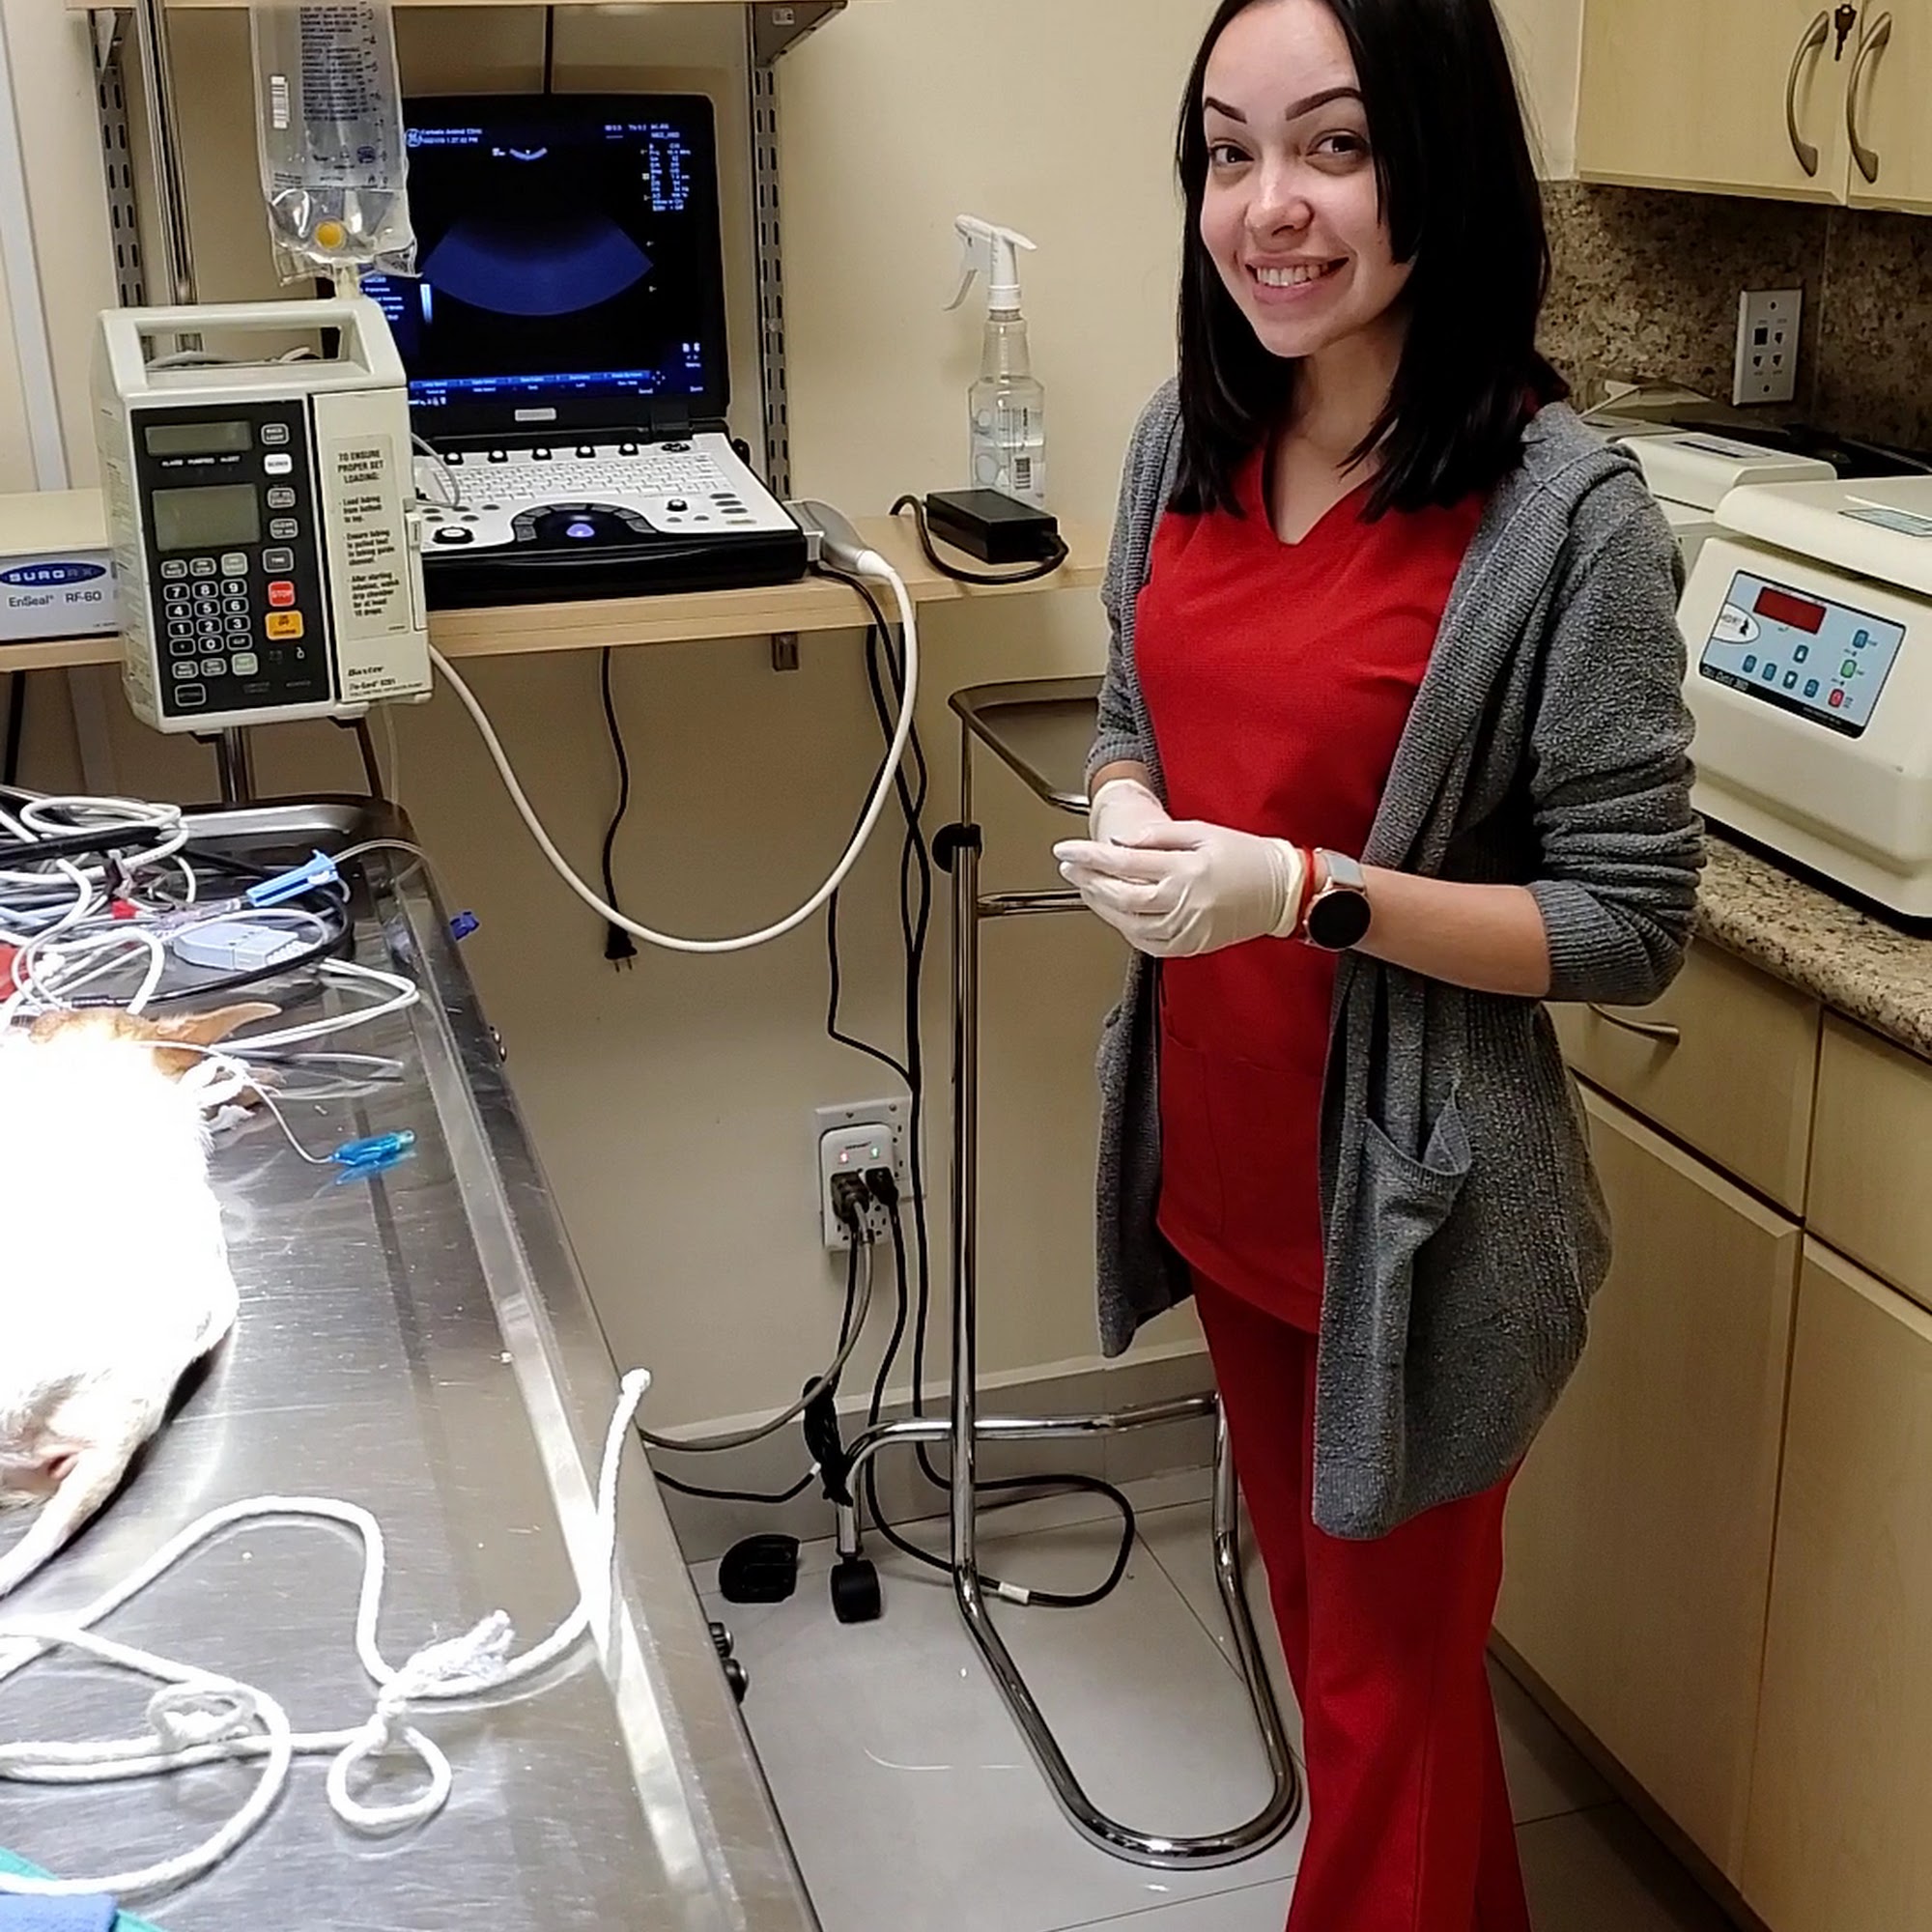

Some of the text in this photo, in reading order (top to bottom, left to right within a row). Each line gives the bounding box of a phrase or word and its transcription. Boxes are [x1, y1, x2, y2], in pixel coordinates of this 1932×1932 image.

[351, 450, 380, 460] ENSURE
[338, 463, 368, 472] PROPER
[172, 582, 239, 598] 7 8 9
[174, 601, 240, 616] 4 5 6
[177, 618, 242, 634] 1 2 3
[206, 639, 215, 650] 0
[348, 667, 384, 676] Baxter
